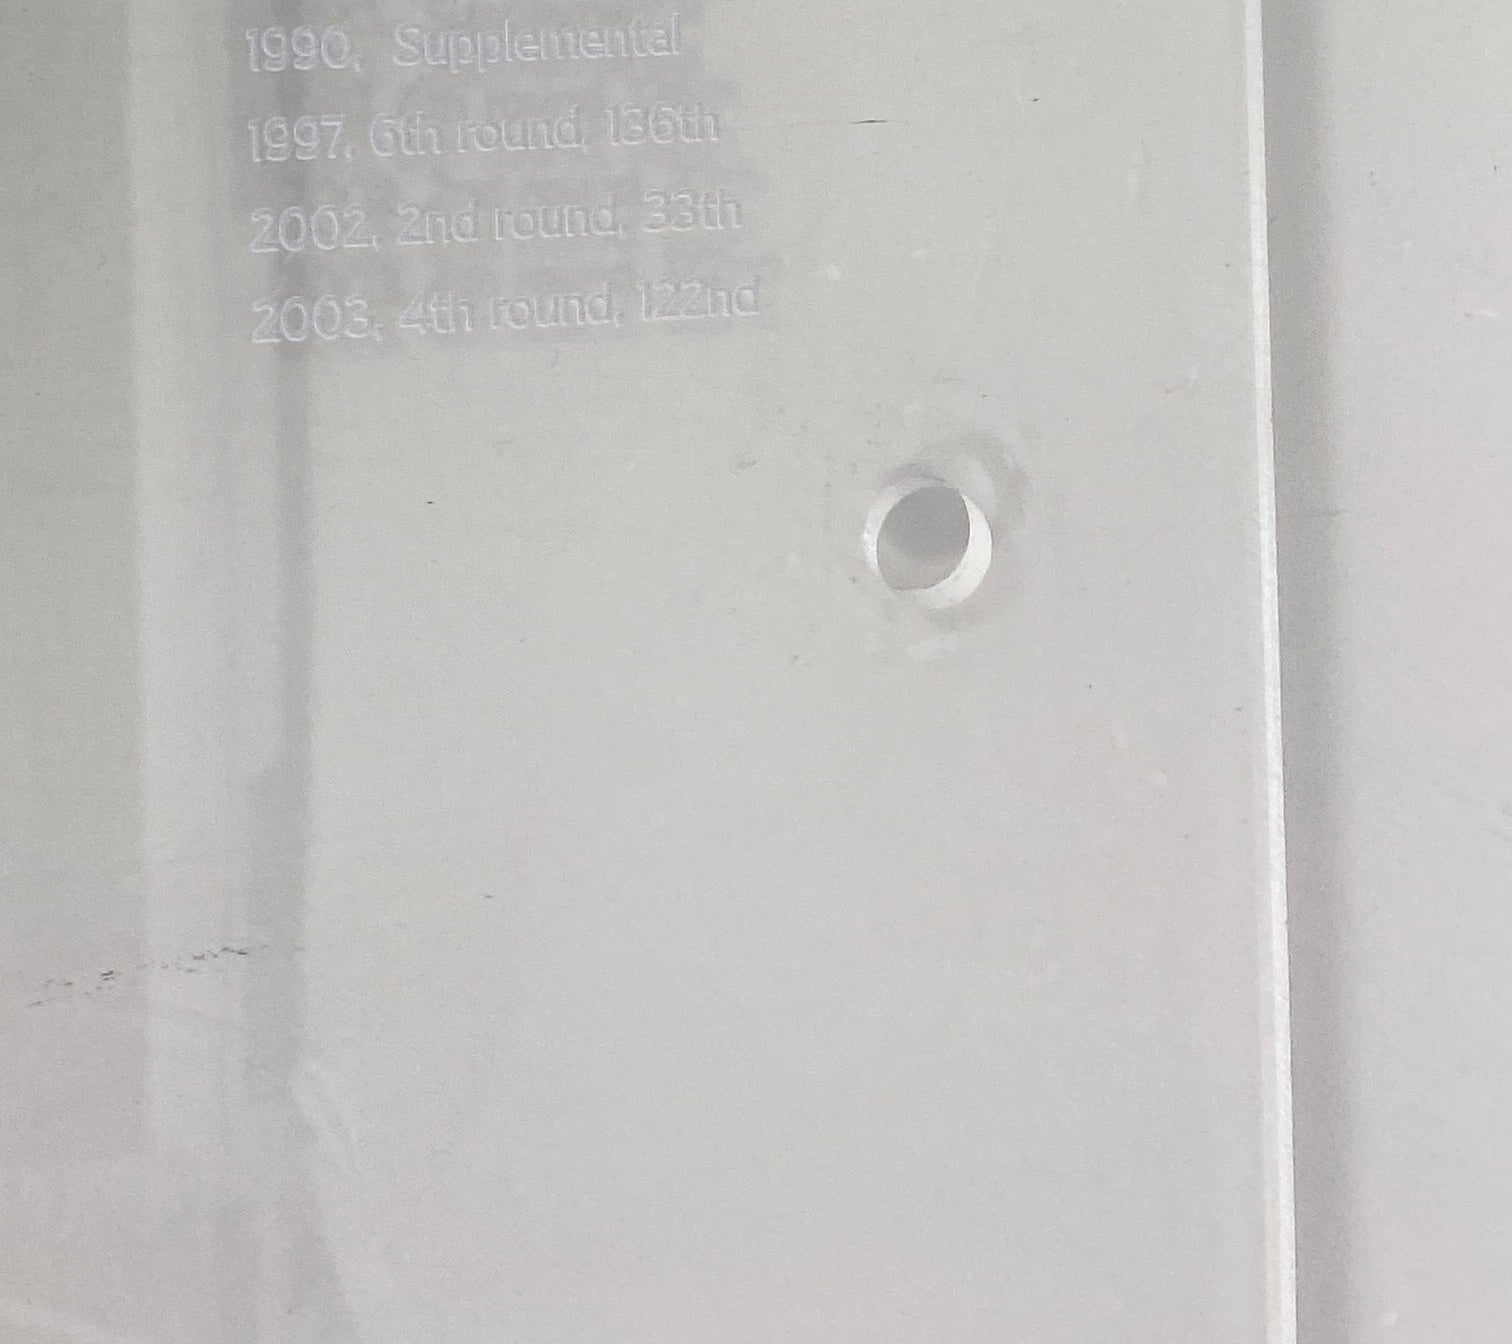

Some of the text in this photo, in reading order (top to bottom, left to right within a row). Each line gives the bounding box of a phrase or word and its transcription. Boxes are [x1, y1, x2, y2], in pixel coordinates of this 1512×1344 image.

[245, 12, 682, 74] 1990, Supplemental
[248, 114, 353, 162] 1997,
[370, 111, 442, 157] 6th
[250, 205, 380, 253] 2002,
[396, 200, 481, 246] 2nd
[398, 290, 474, 335] 4th
